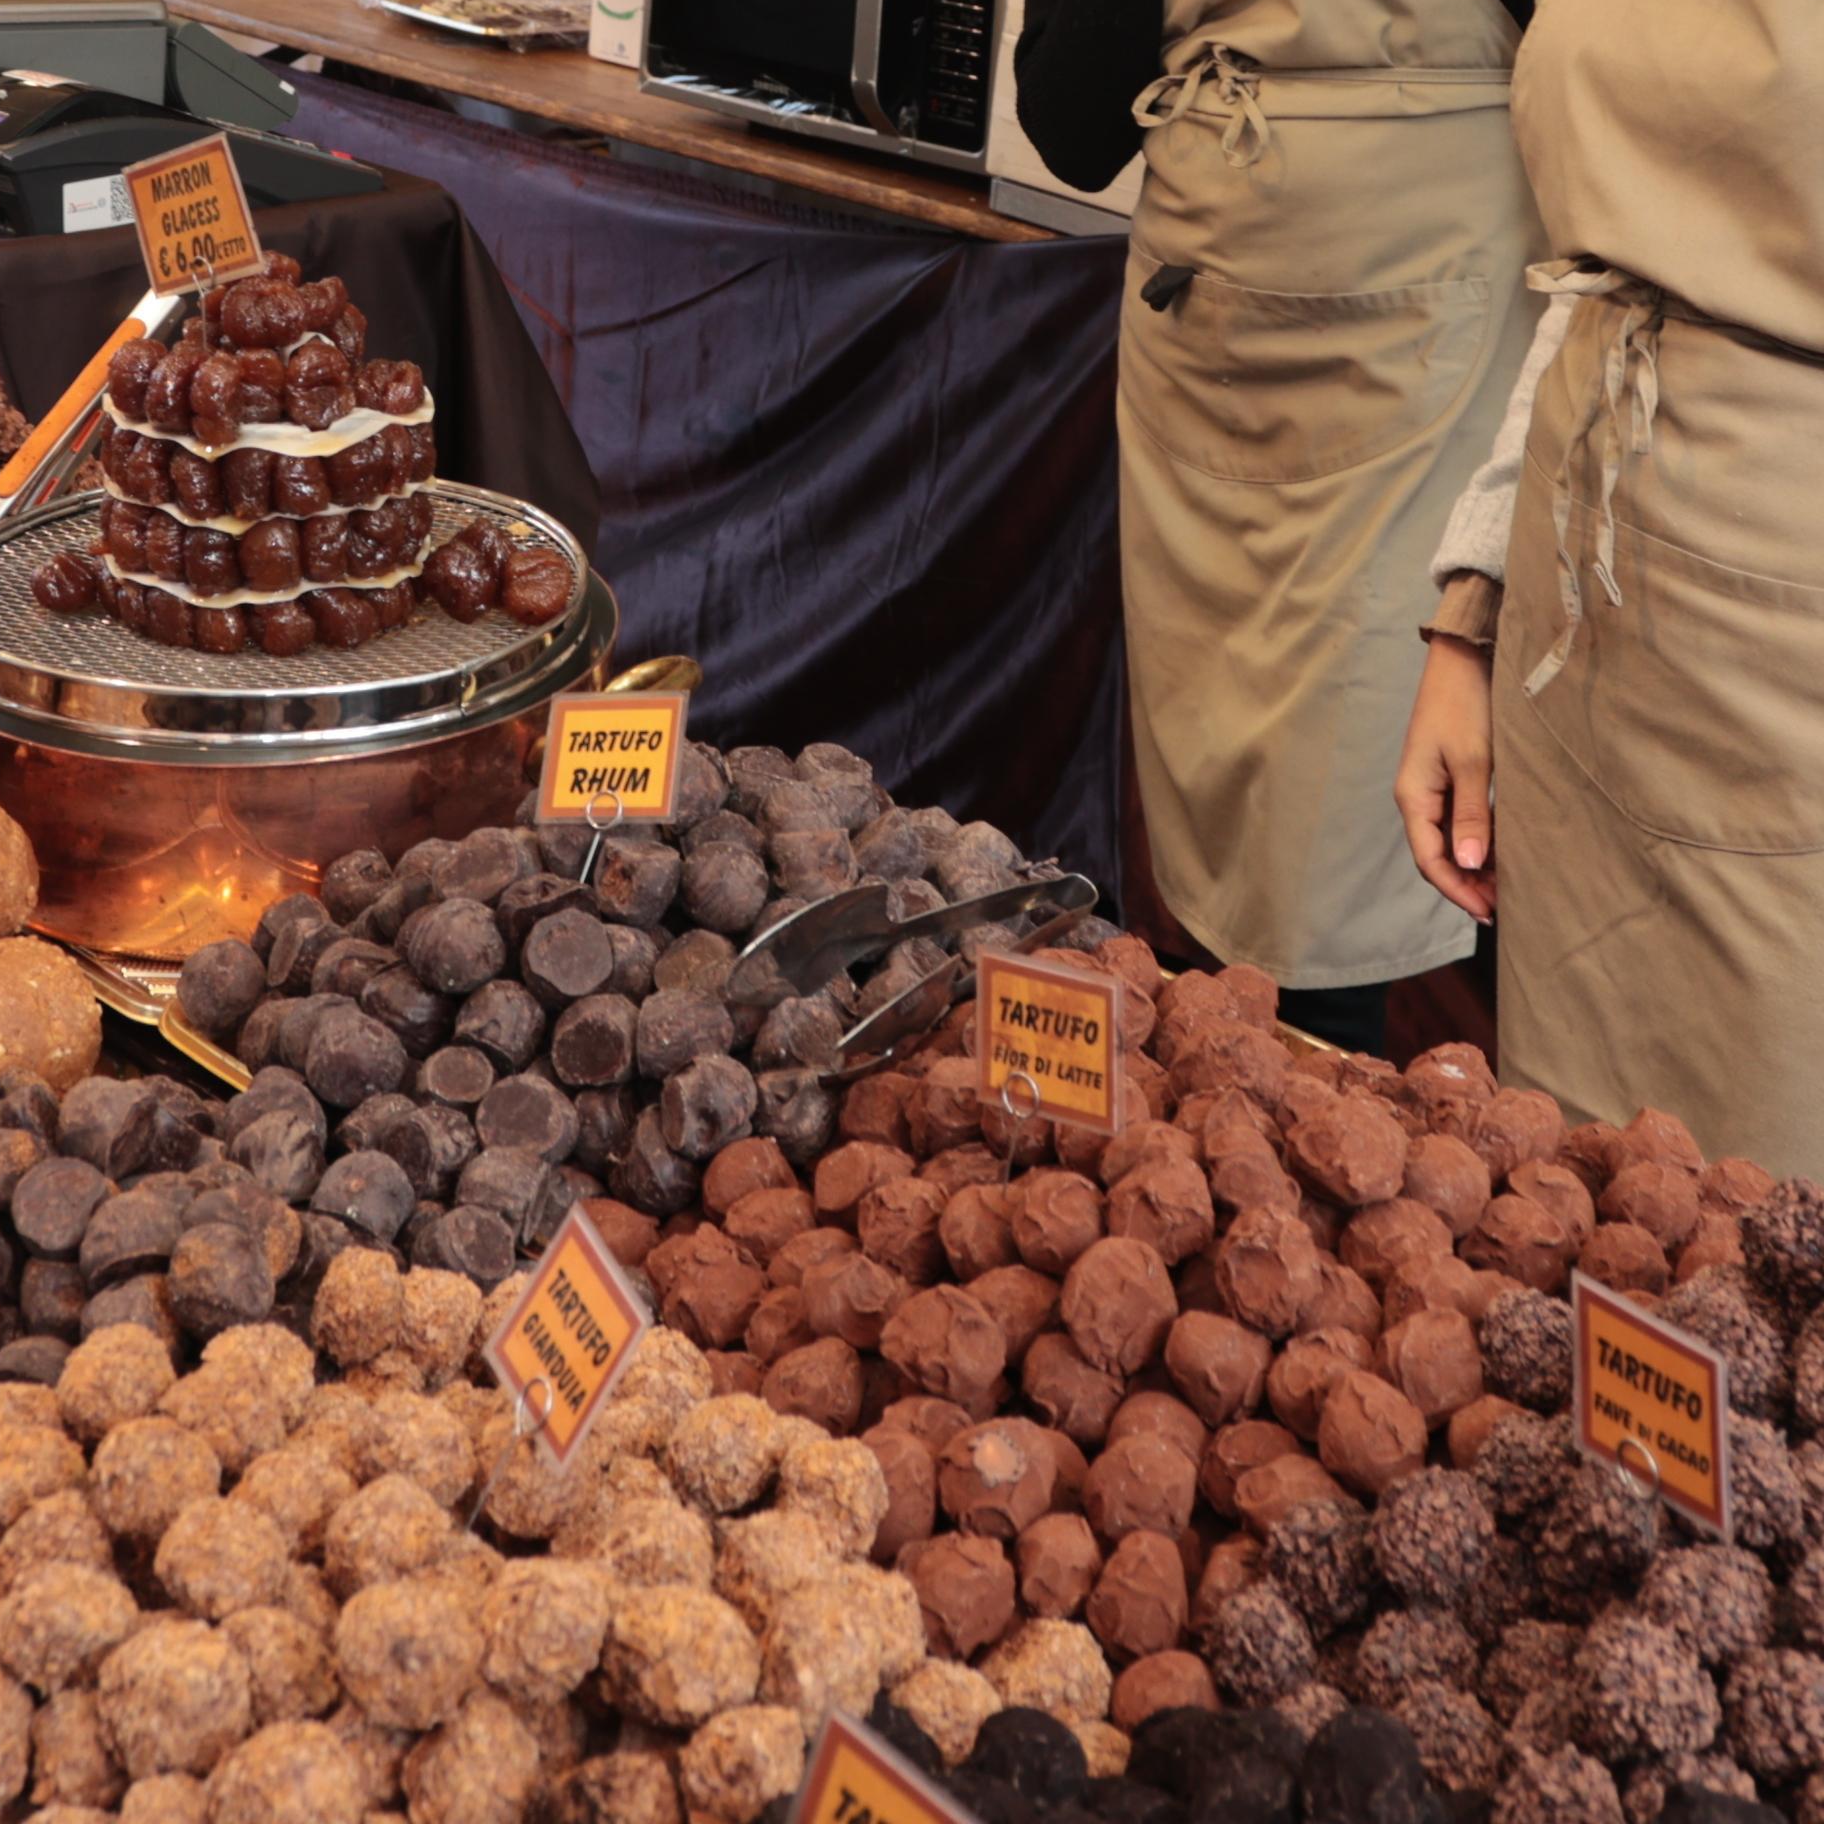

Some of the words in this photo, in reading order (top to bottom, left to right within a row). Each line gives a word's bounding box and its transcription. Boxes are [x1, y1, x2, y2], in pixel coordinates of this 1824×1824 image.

[150, 161, 212, 204] MARRON
[162, 196, 220, 237] GLACESS
[569, 730, 663, 753] TARTUFO
[569, 767, 651, 795] RHUM
[999, 996, 1099, 1045] TARTUFO
[993, 1044, 1029, 1071] FIOR
[1034, 1056, 1052, 1077] DI
[1057, 1061, 1103, 1090] LATTE
[547, 1268, 612, 1367] TARTUFO
[522, 1313, 587, 1416] GIANDUIA
[1596, 1336, 1703, 1422] TARTUFO
[1593, 1391, 1632, 1431] FAVE
[1656, 1431, 1710, 1475] CACAO
